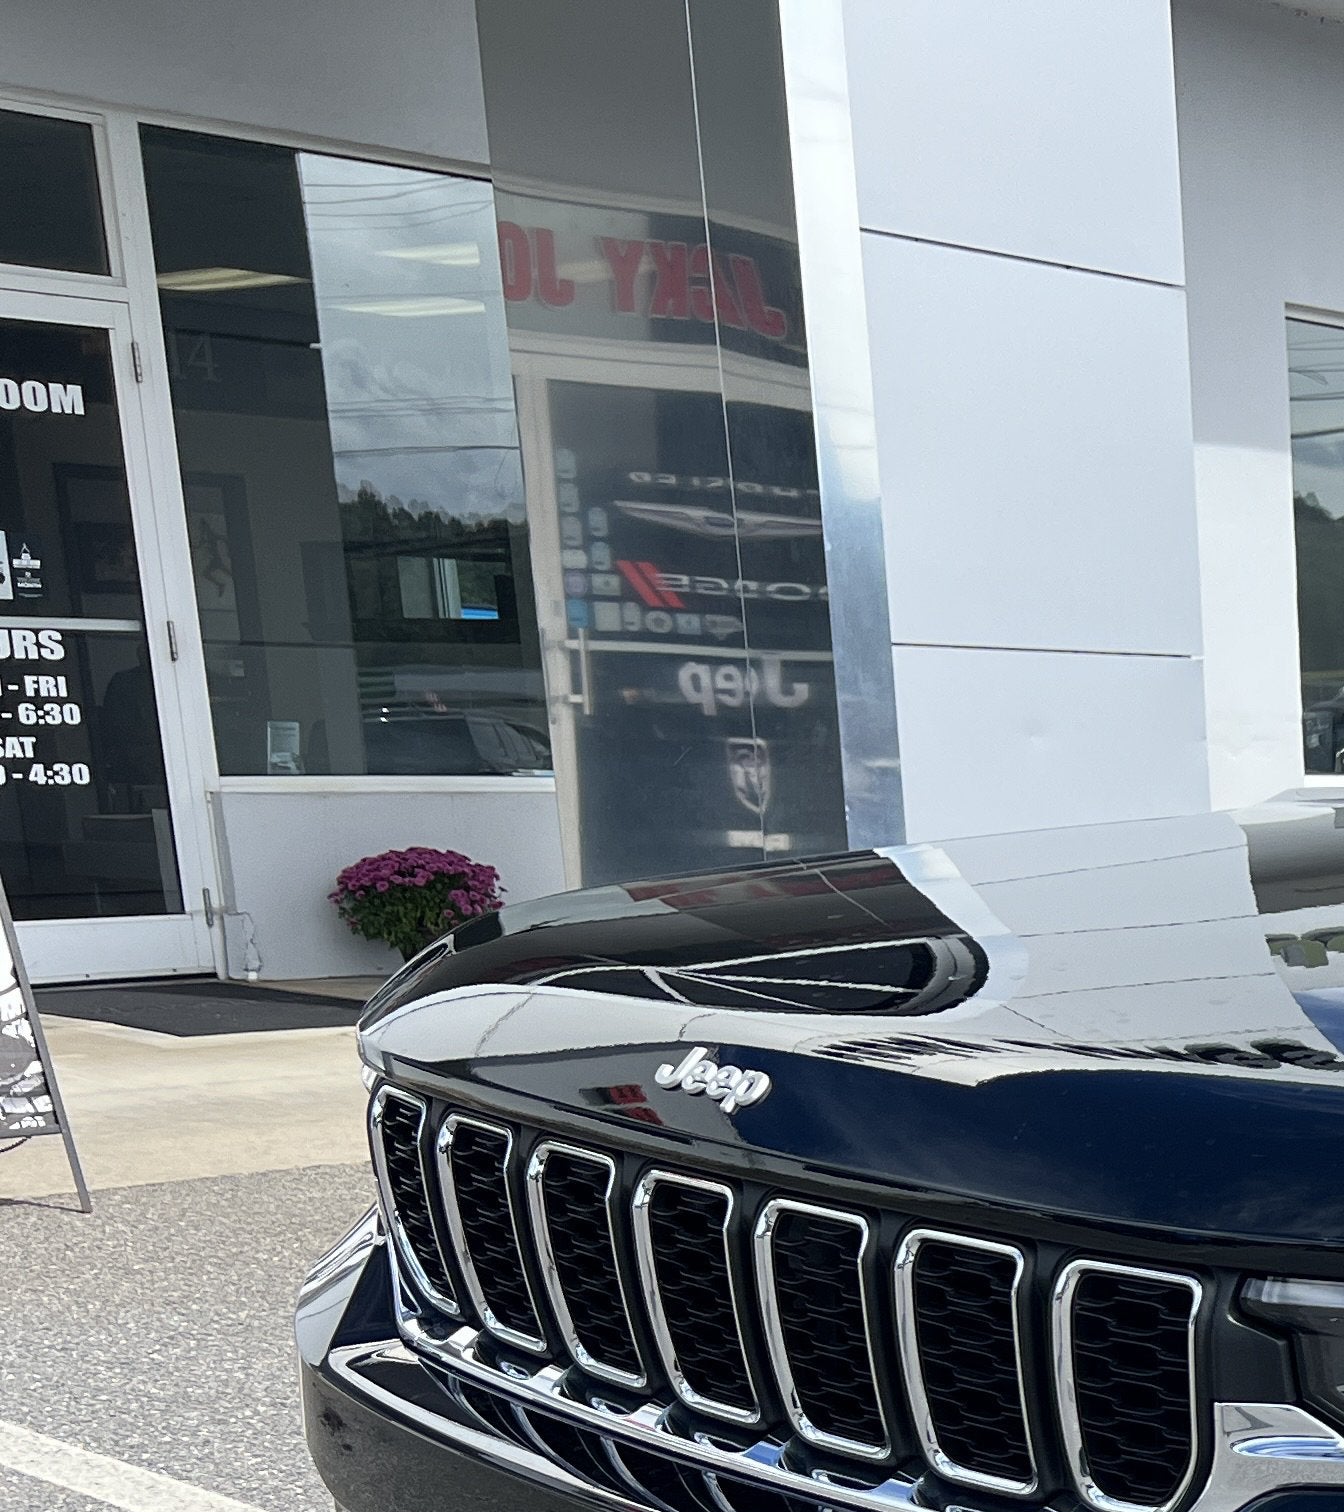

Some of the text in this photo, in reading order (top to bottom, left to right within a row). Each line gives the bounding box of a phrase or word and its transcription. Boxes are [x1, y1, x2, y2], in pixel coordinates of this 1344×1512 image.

[24, 675, 68, 698] FRI
[18, 703, 82, 725] 6:30
[0, 736, 36, 759] AT
[29, 763, 90, 785] 4:30
[655, 1046, 772, 1114] Jeep
